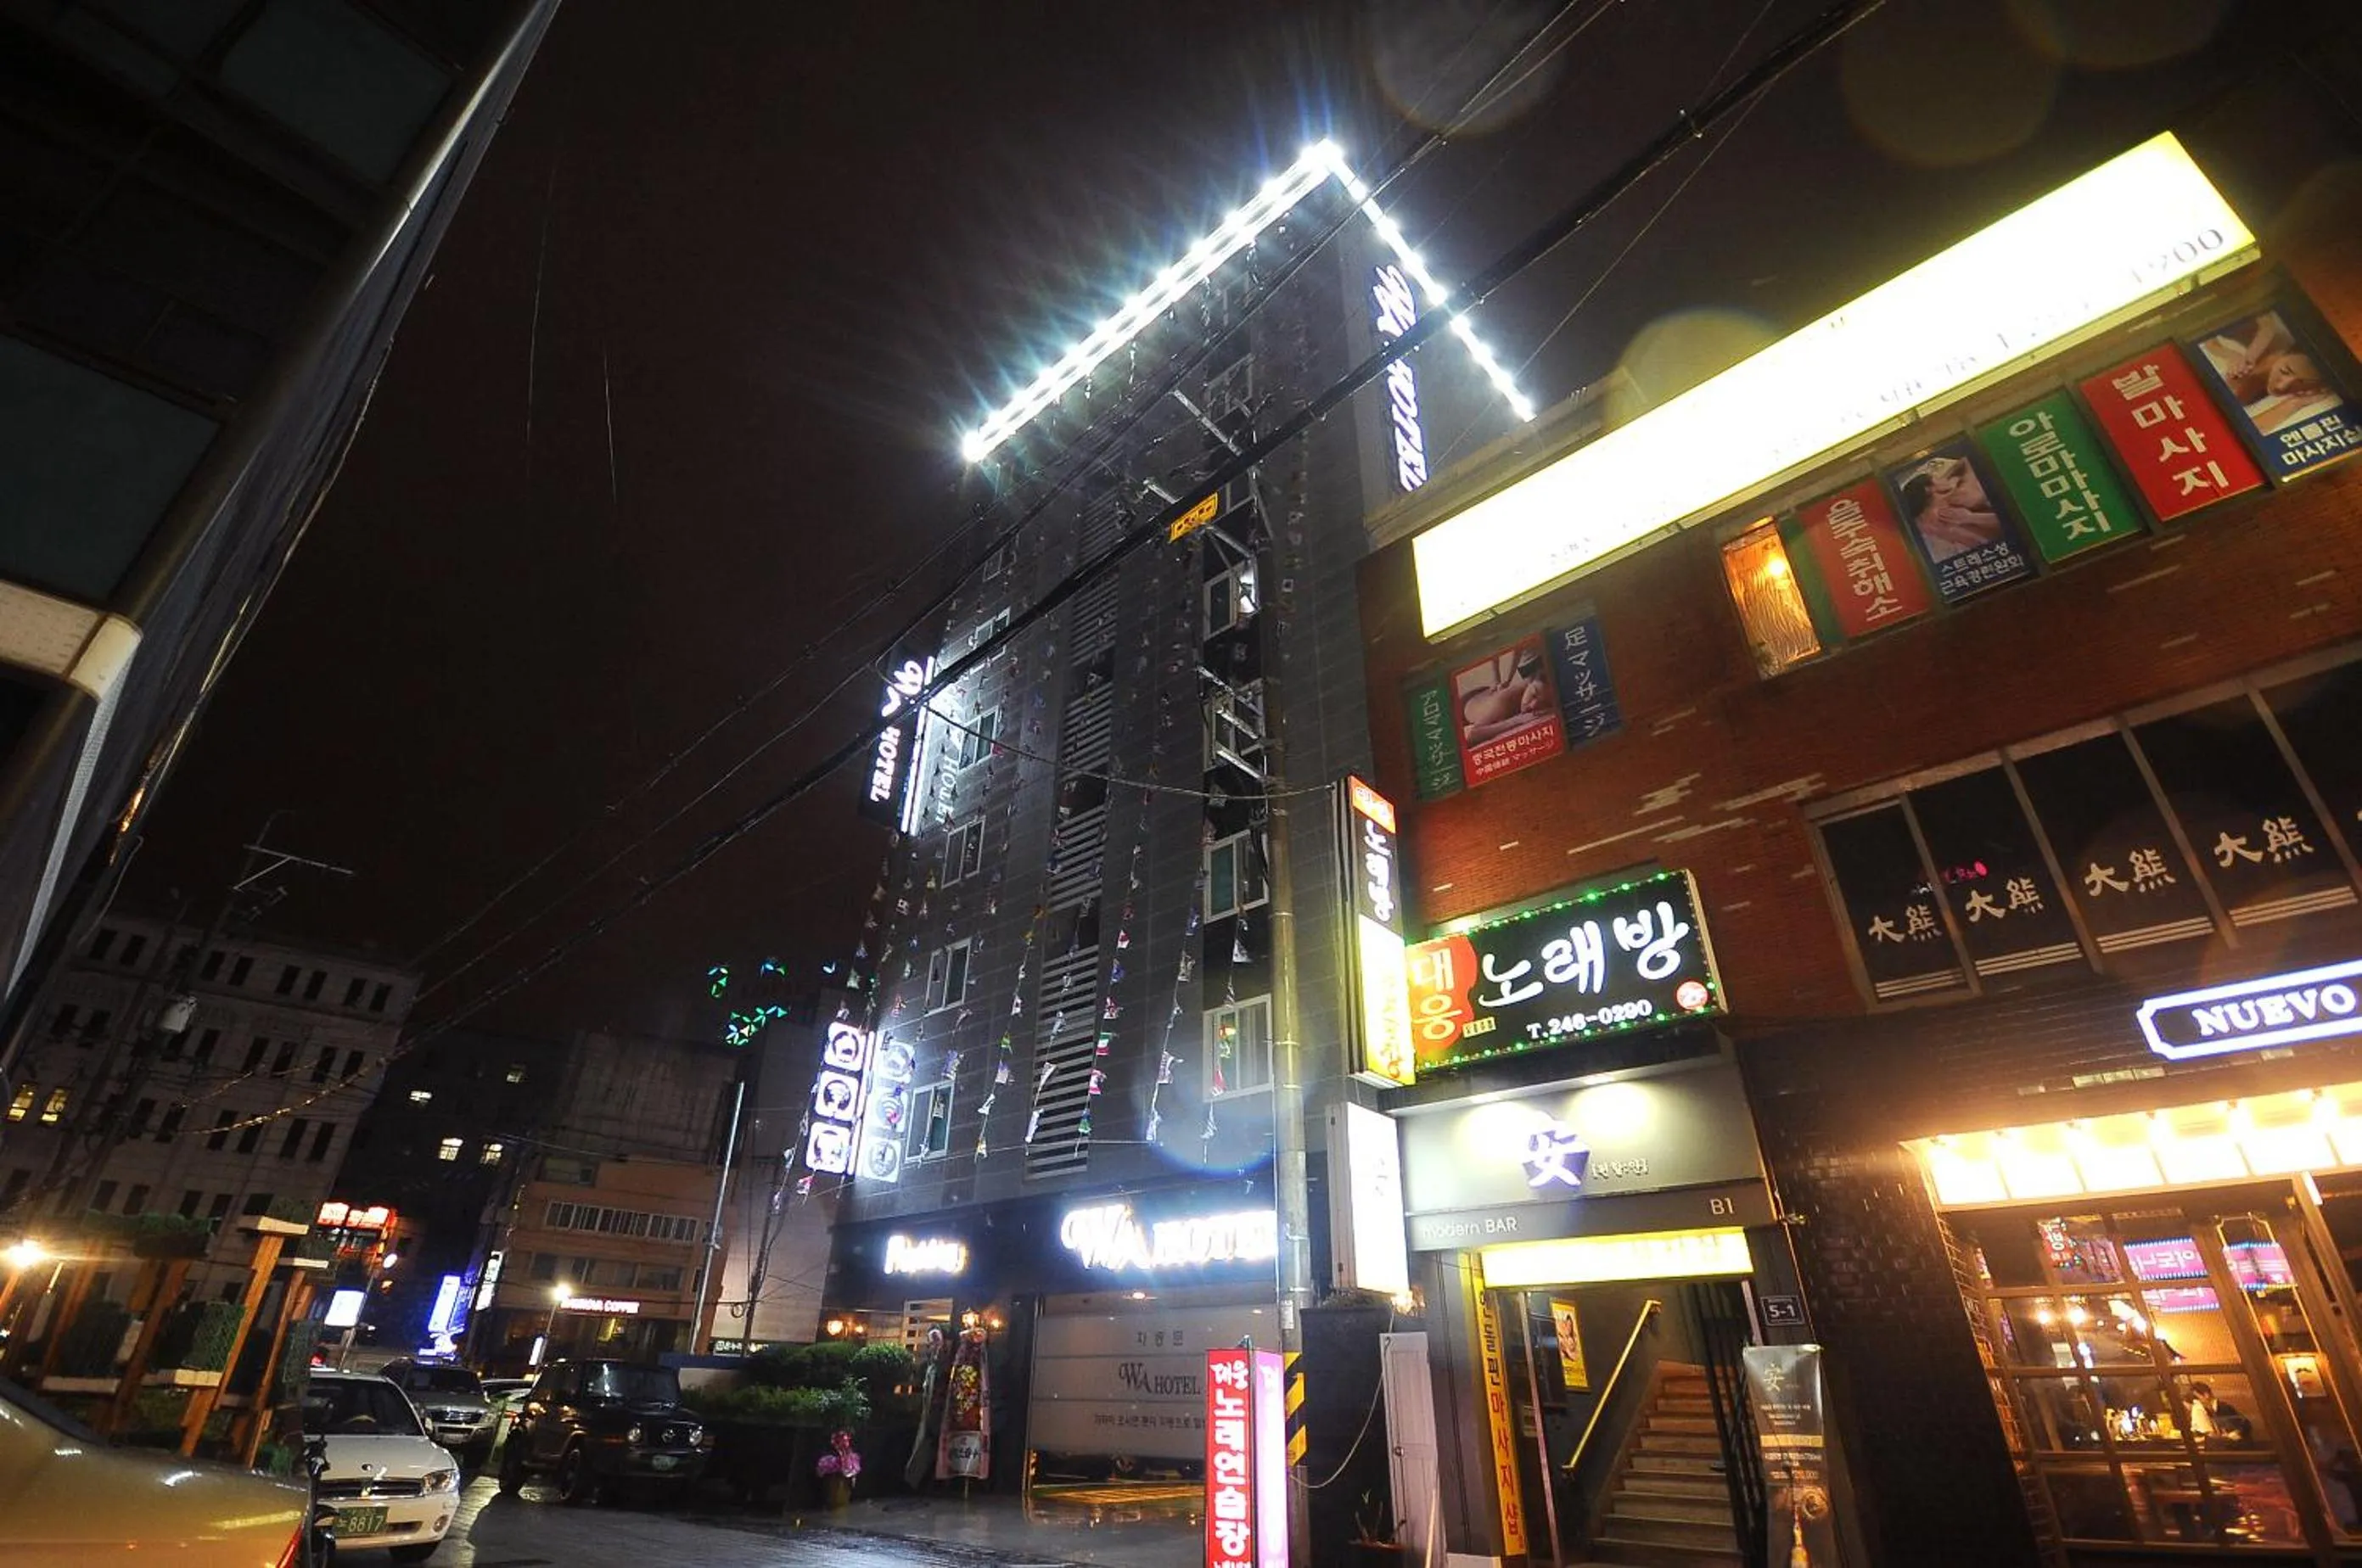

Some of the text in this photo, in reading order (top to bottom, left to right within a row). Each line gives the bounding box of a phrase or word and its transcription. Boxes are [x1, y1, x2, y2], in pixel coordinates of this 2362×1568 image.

[870, 725, 901, 803] HOTEL
[2213, 816, 2314, 868] 大熊
[2084, 848, 2177, 897] 大熊
[1965, 876, 2045, 923] 大熊
[1868, 904, 1943, 944] 大熊
[1478, 901, 1690, 1007] 노래방
[2191, 983, 2358, 1040] NUEVO
[1485, 1216, 1518, 1234] BAR
[1709, 1197, 1735, 1216] B1
[1769, 1304, 1796, 1319] 5-1
[1154, 1375, 1202, 1396] HOTEL
[348, 1515, 384, 1532] 8817
